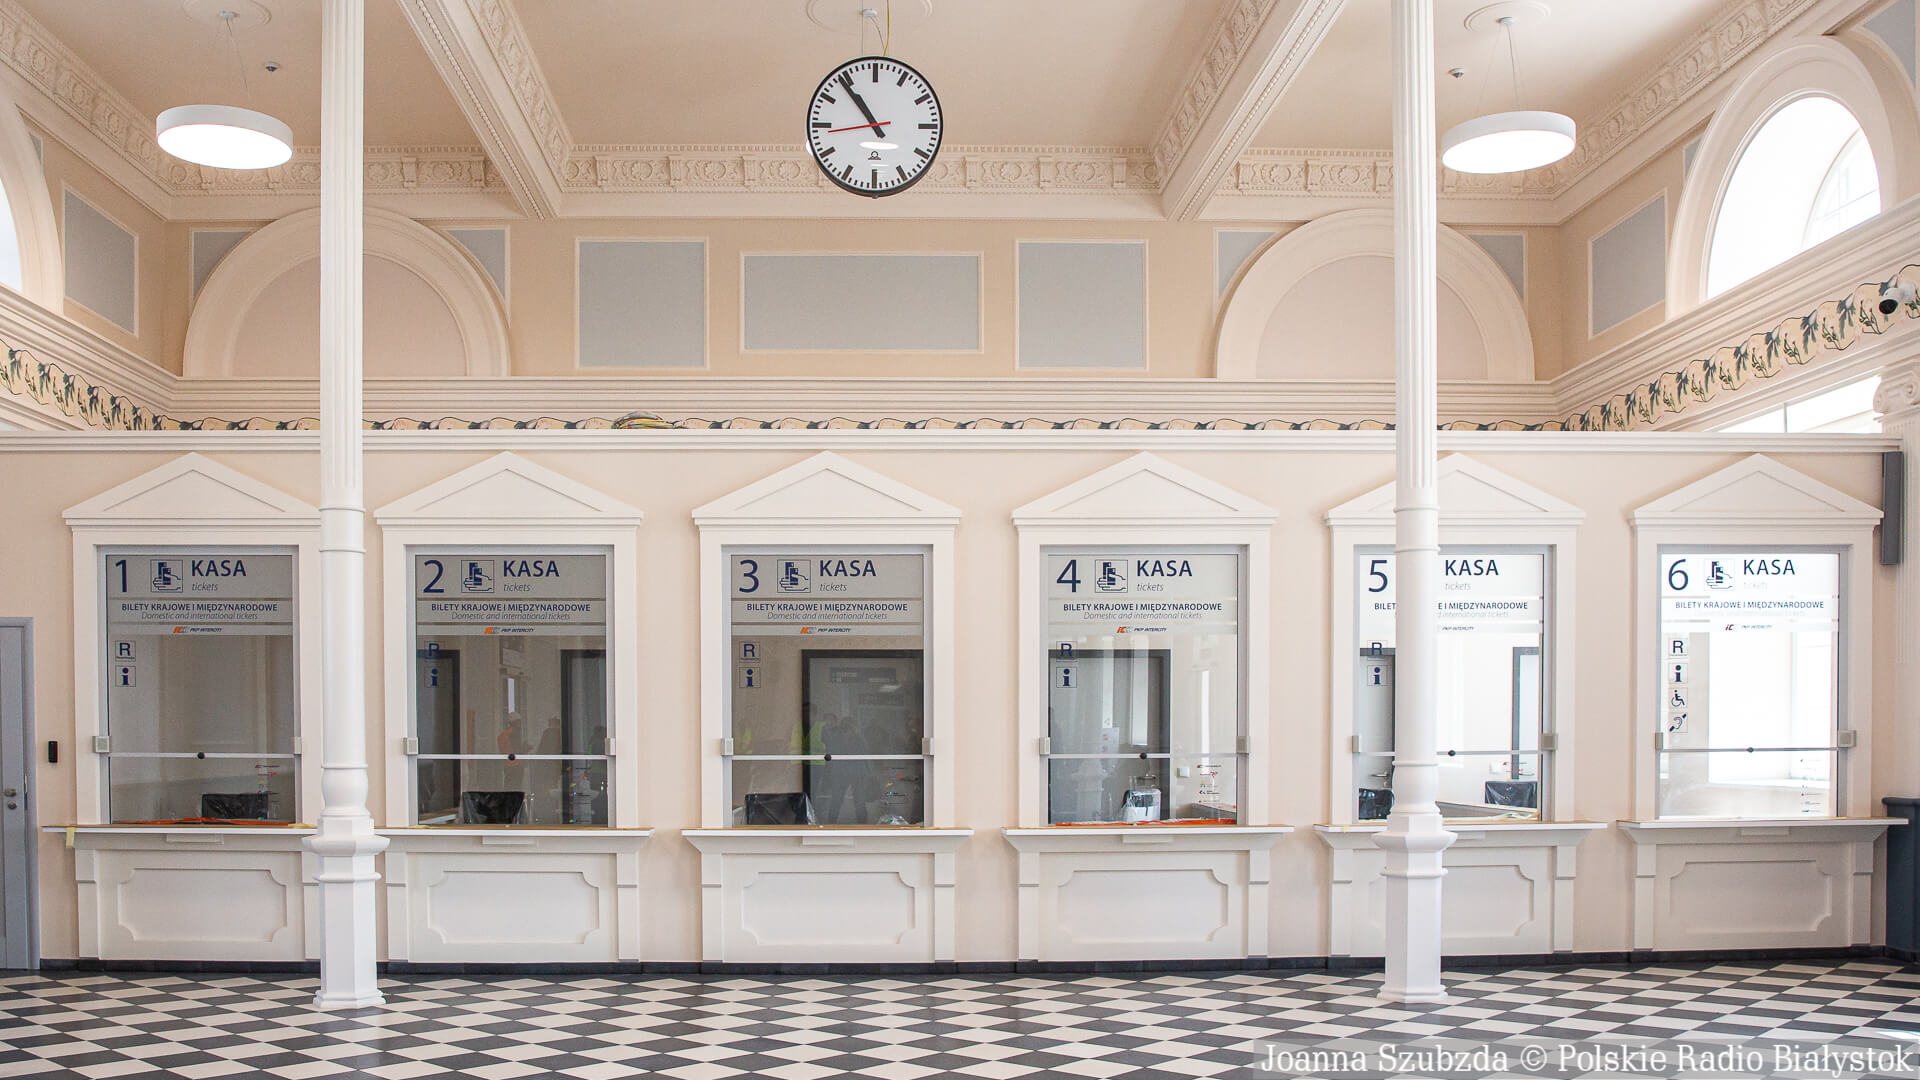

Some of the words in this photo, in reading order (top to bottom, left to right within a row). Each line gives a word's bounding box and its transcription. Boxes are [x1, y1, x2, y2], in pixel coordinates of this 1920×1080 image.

[191, 560, 246, 576] KASA
[503, 560, 560, 577] KASA
[820, 560, 876, 576] KASA
[1137, 560, 1192, 576] KASA
[1445, 560, 1499, 576] KASA
[1668, 558, 1689, 590] 6
[1744, 560, 1796, 575] KASA
[115, 560, 128, 592] 1
[423, 560, 444, 593] 2
[738, 560, 760, 593] 3
[1056, 560, 1081, 592] 4
[1368, 560, 1388, 592] 5
[191, 582, 218, 591] tickets
[504, 583, 531, 592] tickets
[820, 582, 848, 592] tickets
[1136, 582, 1164, 592] tickets
[196, 604, 278, 612] MIĘDZYNARODOWE
[508, 604, 590, 613] MIĘDZYNARODOWE
[824, 604, 908, 612] MIĘDZYNARODOWE
[1140, 604, 1222, 612] MIĘDZYNARODOWE
[1448, 602, 1528, 611] MIĘDZYNARODOWE
[1748, 602, 1824, 610] MIĘDZYNARODOWE
[119, 643, 131, 656] R
[428, 643, 440, 656] R
[744, 644, 754, 657] R
[1061, 644, 1072, 656] R
[1673, 640, 1684, 654] R
